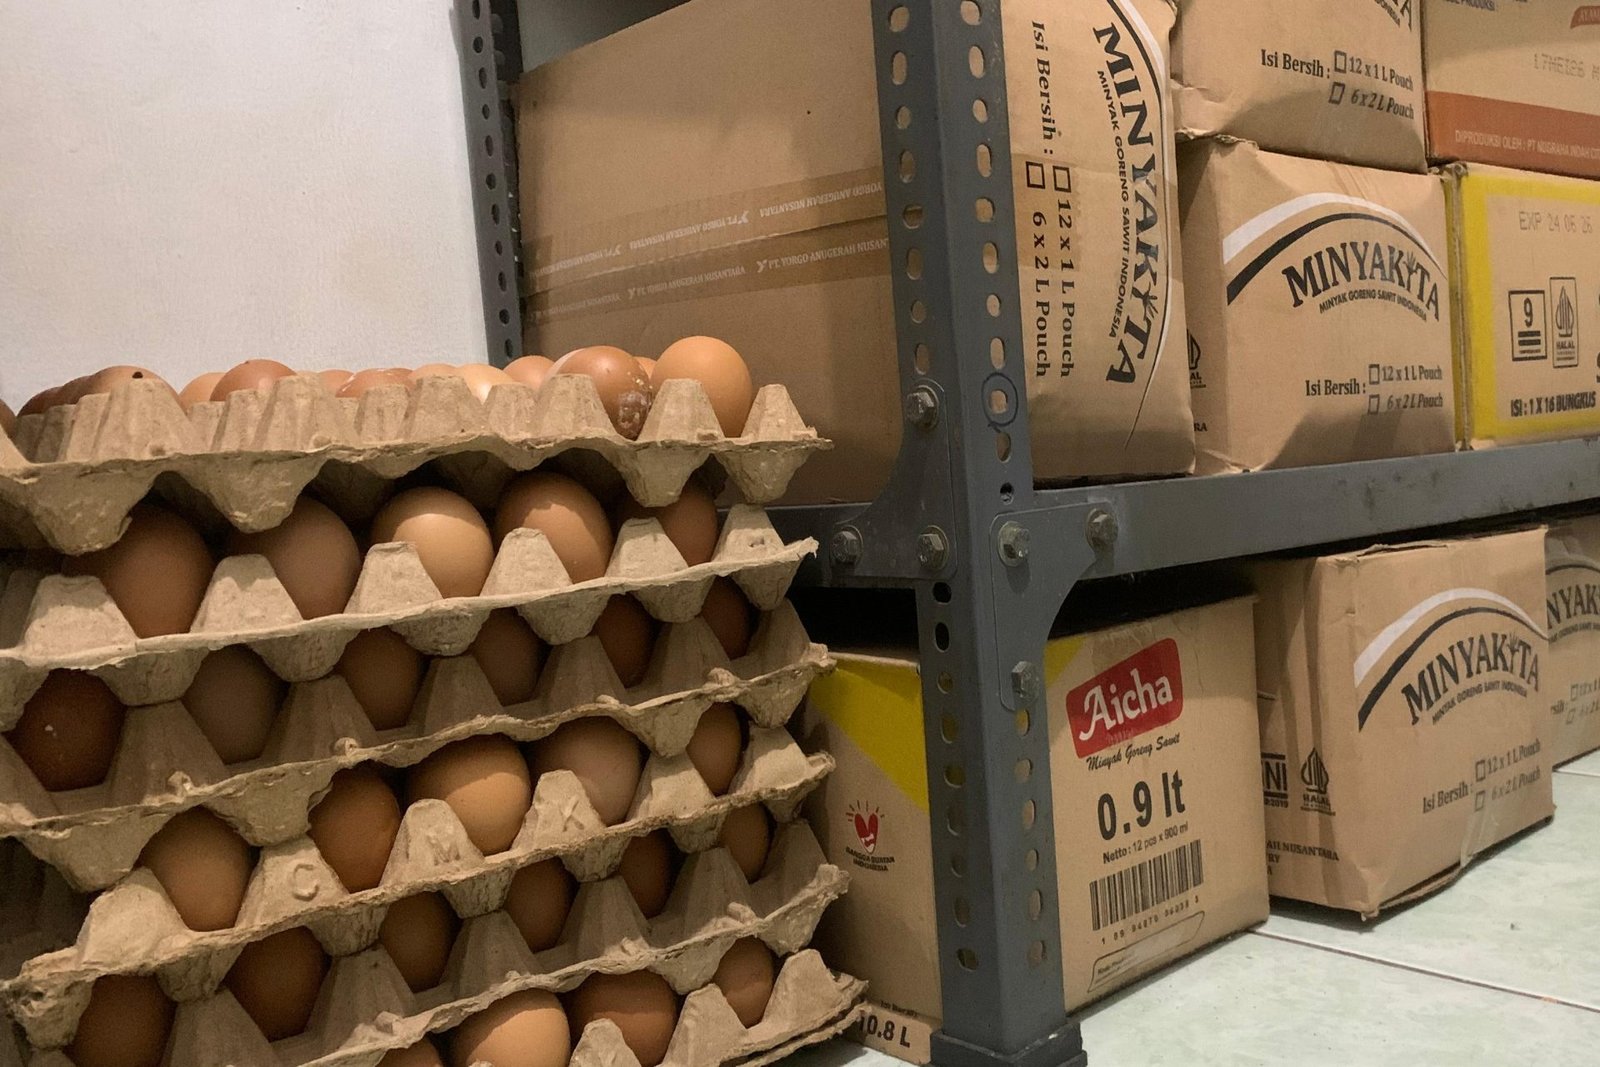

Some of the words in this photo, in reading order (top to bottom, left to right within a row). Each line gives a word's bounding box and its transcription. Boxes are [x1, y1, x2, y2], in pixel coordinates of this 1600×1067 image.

[1032, 20, 1048, 52] Isi
[1261, 49, 1279, 68] Isi
[1282, 52, 1324, 78] Bersih
[1349, 56, 1362, 74] 12
[1365, 64, 1372, 77] x
[1374, 64, 1380, 79] 1
[1382, 66, 1388, 82] L
[1389, 68, 1414, 92] Pouch
[1037, 58, 1057, 140] Bersih
[1097, 70, 1120, 131] MINYAK
[1351, 88, 1359, 105] 6
[1359, 94, 1366, 107] x
[1368, 93, 1377, 108] 2
[1377, 94, 1384, 111] L
[1386, 97, 1415, 120] Pouch
[1114, 135, 1129, 201] GORENG
[853, 182, 882, 197] YORGO
[759, 198, 806, 218] NUSANTARA
[1032, 211, 1047, 227] 6
[1057, 199, 1073, 229] 12
[1519, 211, 1541, 231] EXP
[1034, 233, 1045, 248] x
[1060, 236, 1071, 250] x
[1121, 206, 1130, 254] SAWIT
[781, 252, 809, 268] YORGO
[810, 244, 856, 262] ANUGERAH
[1035, 256, 1049, 269] 2
[1061, 259, 1075, 271] 1
[1035, 279, 1050, 293] L
[1061, 281, 1075, 294] L
[1109, 257, 1129, 339] INDONESIA
[1319, 292, 1348, 314] MINYAK
[1348, 289, 1377, 301] GORENG
[1377, 289, 1396, 302] SAWIT
[1397, 295, 1428, 322] INDONESIA
[1036, 301, 1051, 377] Pouch
[1061, 302, 1075, 378] Pouch
[1305, 379, 1321, 396] Isi
[1324, 378, 1360, 396] Bersih
[1381, 365, 1393, 381] 12
[1396, 369, 1402, 380] x
[1404, 366, 1410, 381] 1
[1411, 366, 1417, 380] L
[1418, 365, 1443, 380] Pouch
[1387, 395, 1394, 410] 6
[1395, 398, 1402, 410] x
[1402, 394, 1410, 409] 2
[1410, 394, 1417, 408] L
[1417, 393, 1443, 408] Pouch
[1511, 398, 1523, 417] ISI
[1536, 397, 1542, 414] X
[1556, 391, 1596, 412] BUNGKUS
[1078, 667, 1173, 742] Aicha
[1432, 697, 1457, 726] MINYAK
[1086, 750, 1122, 772] Minyak
[1125, 743, 1153, 764] Goreng
[1156, 732, 1180, 751] Sawit
[1488, 756, 1498, 775] 12
[1519, 738, 1541, 760] Pouch
[1518, 765, 1541, 788] Pouch
[1097, 780, 1152, 841] 0.9
[1161, 769, 1186, 819] lt
[1423, 793, 1436, 814] Isi
[1437, 781, 1469, 808] Bersih
[1132, 839, 1142, 854] 12
[1144, 834, 1157, 850] pcs
[1158, 832, 1164, 842] x
[1164, 825, 1179, 841] 900
[1179, 821, 1189, 835] ml
[1282, 842, 1340, 861] NUSANTARA
[900, 1025, 910, 1048] L
